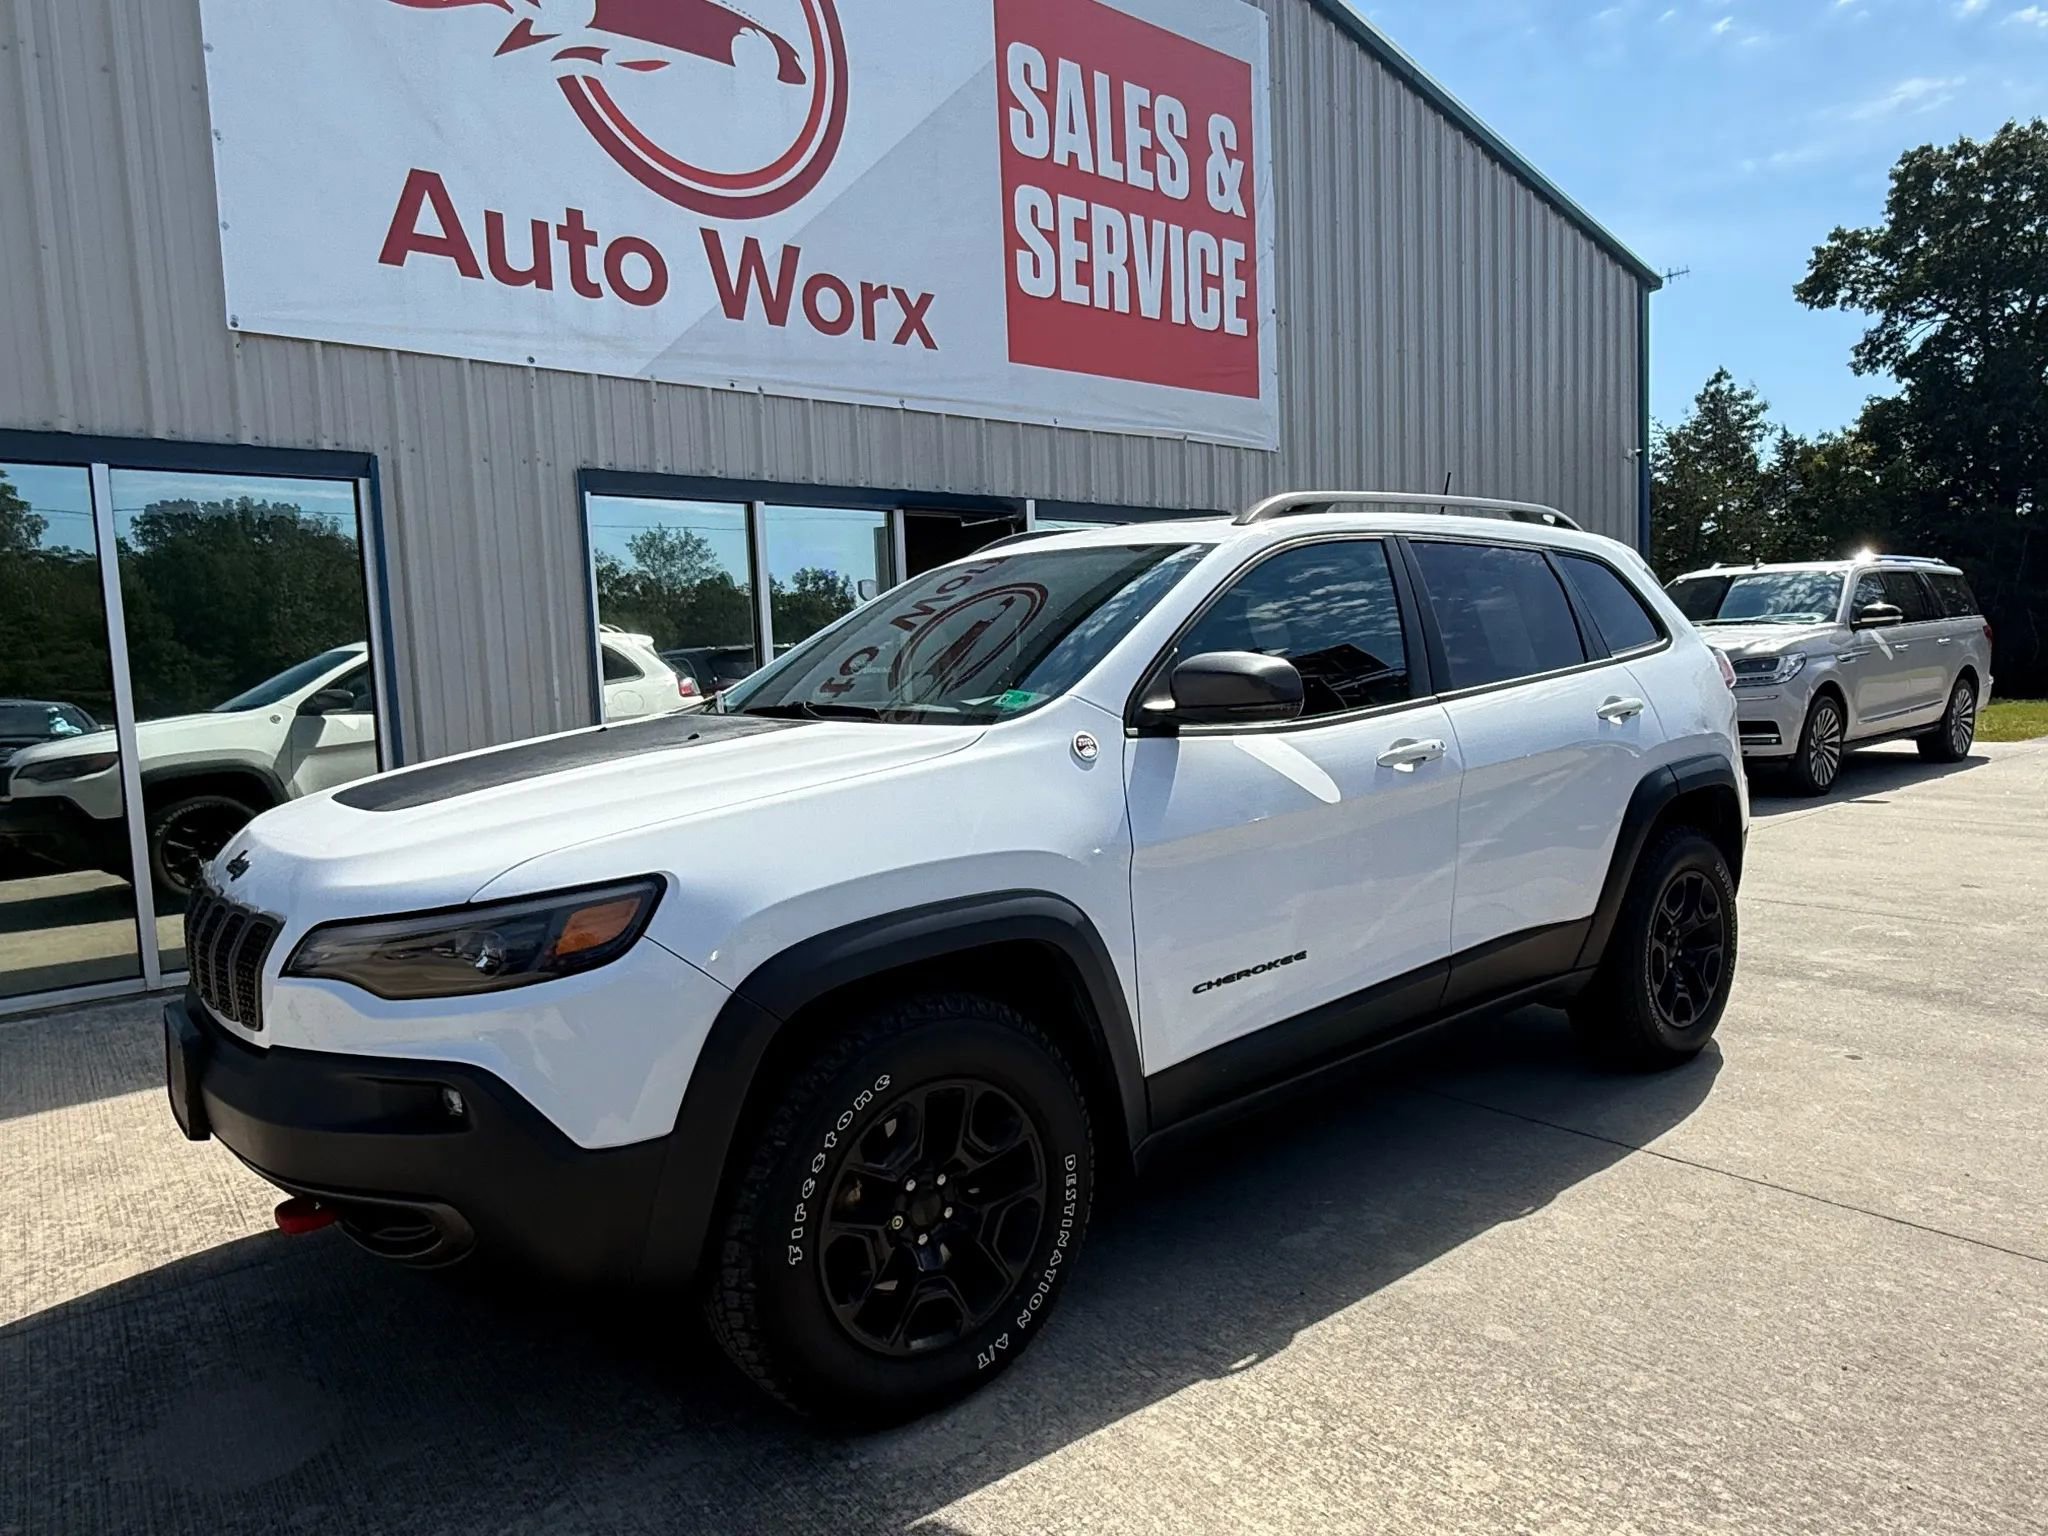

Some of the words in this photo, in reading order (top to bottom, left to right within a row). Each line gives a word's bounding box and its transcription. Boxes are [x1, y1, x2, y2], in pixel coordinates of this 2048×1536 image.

[1006, 41, 1190, 200] SALES
[1206, 113, 1247, 218] &
[378, 167, 669, 307] Auto
[700, 228, 939, 351] Worx
[1014, 184, 1248, 337] SERVICE
[1192, 950, 1308, 995] CHEROKEE
[1016, 1154, 1077, 1329] DESTINATION
[977, 1333, 1009, 1369] A/T
